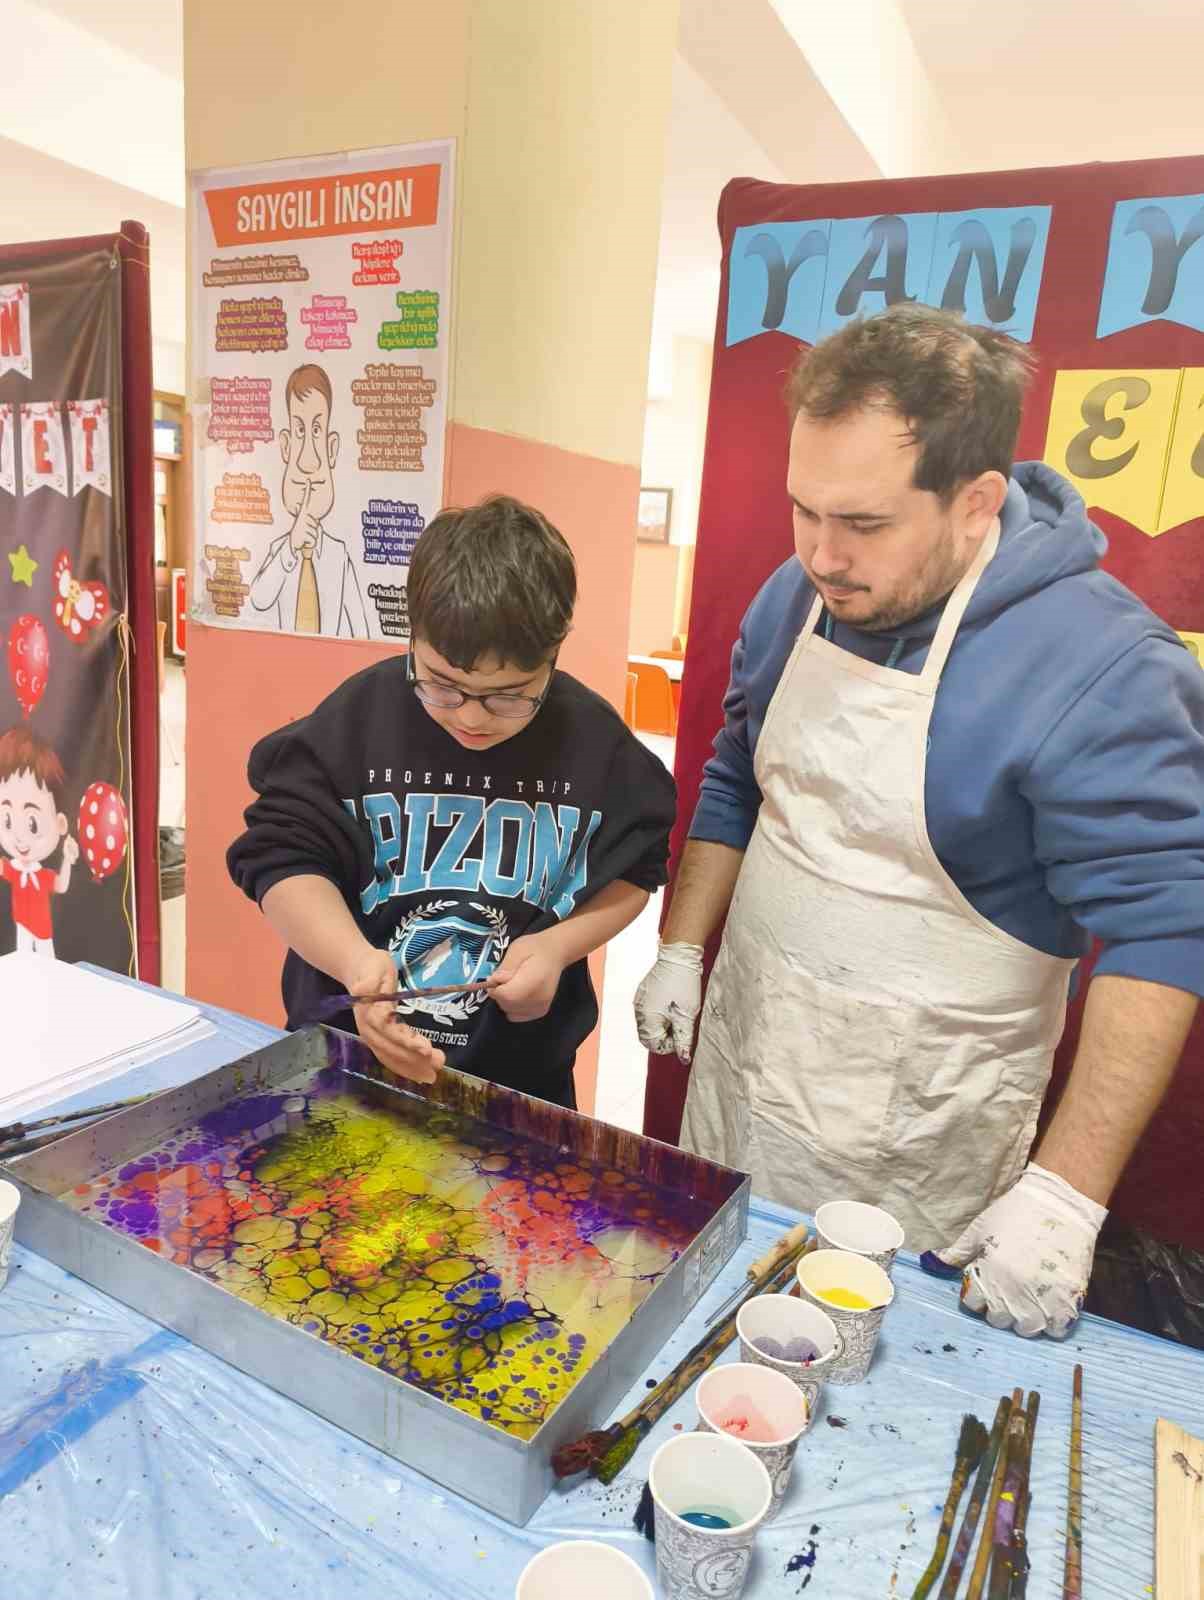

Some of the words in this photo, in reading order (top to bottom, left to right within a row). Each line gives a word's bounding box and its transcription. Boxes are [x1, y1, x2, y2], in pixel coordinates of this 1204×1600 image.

[237, 189, 326, 233] SAYGILI
[334, 179, 414, 225] İNSAN
[744, 215, 1038, 329] YAN
[370, 501, 405, 515] Bitkilerin
[408, 503, 417, 514] ve
[362, 513, 411, 528] hayvanların
[412, 516, 424, 528] da
[368, 768, 492, 790] PHOENIX
[440, 1031, 469, 1046] STATES
